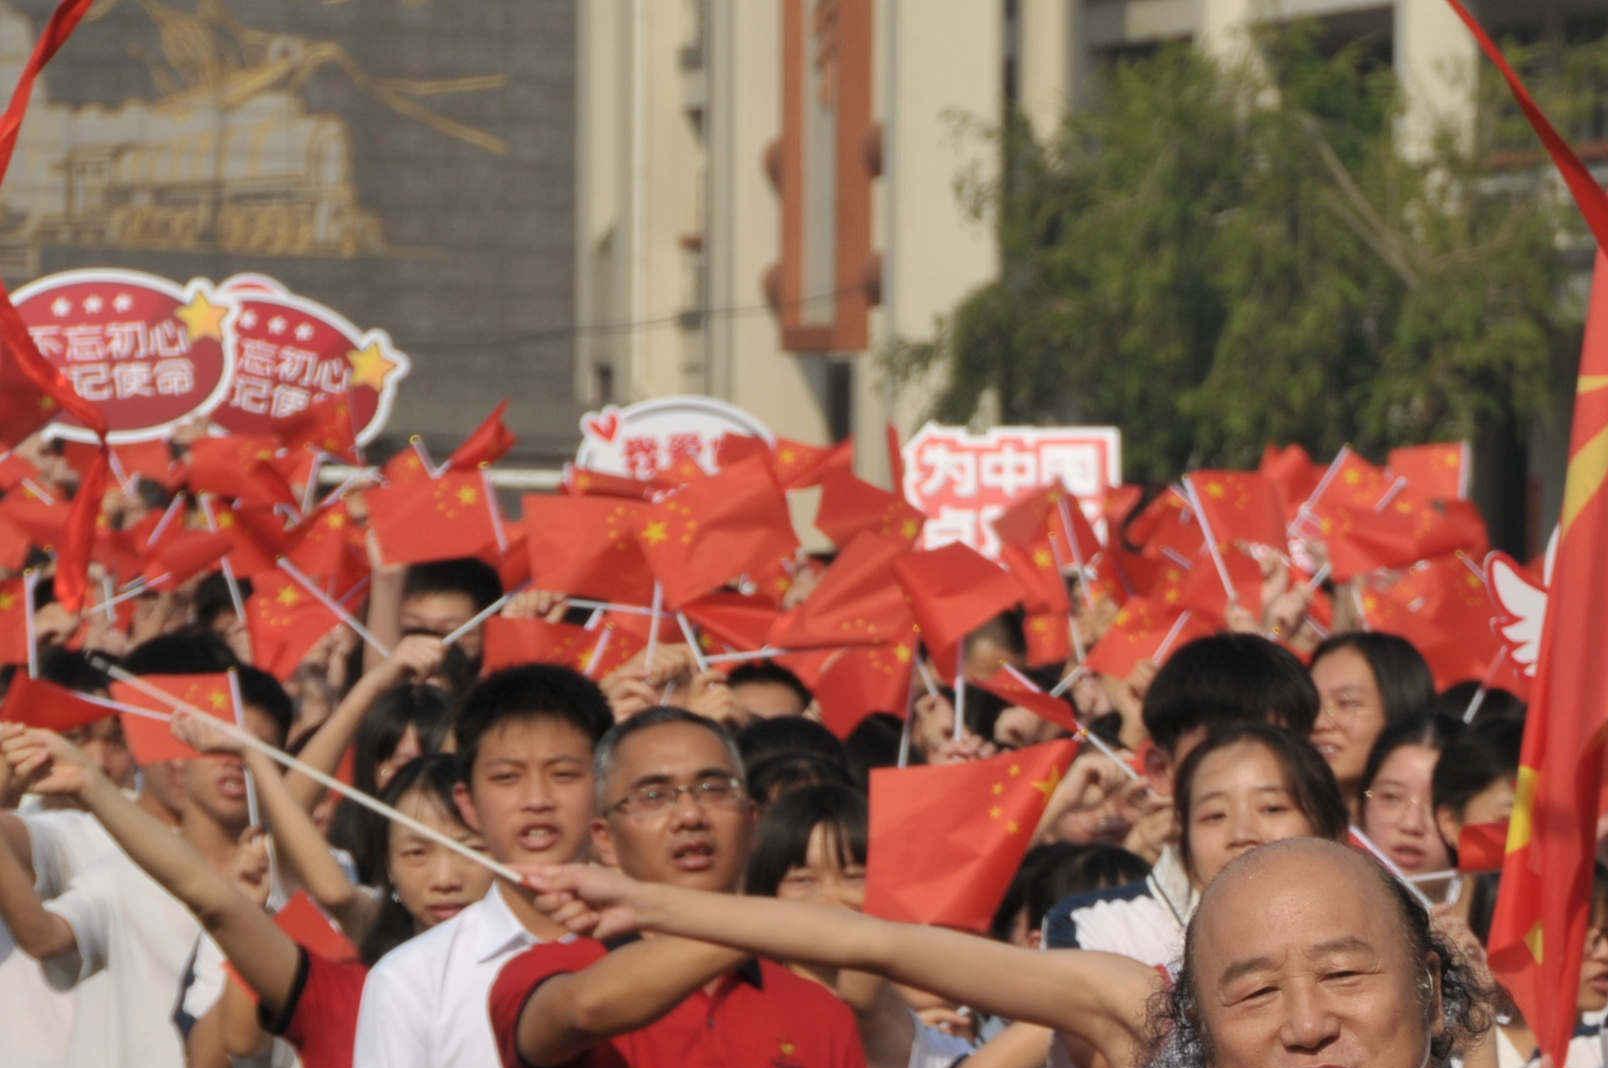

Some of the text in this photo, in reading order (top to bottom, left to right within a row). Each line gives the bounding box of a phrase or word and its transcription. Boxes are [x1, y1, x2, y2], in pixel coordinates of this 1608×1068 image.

[60, 358, 195, 402] 记使命
[230, 376, 328, 419] 记使
